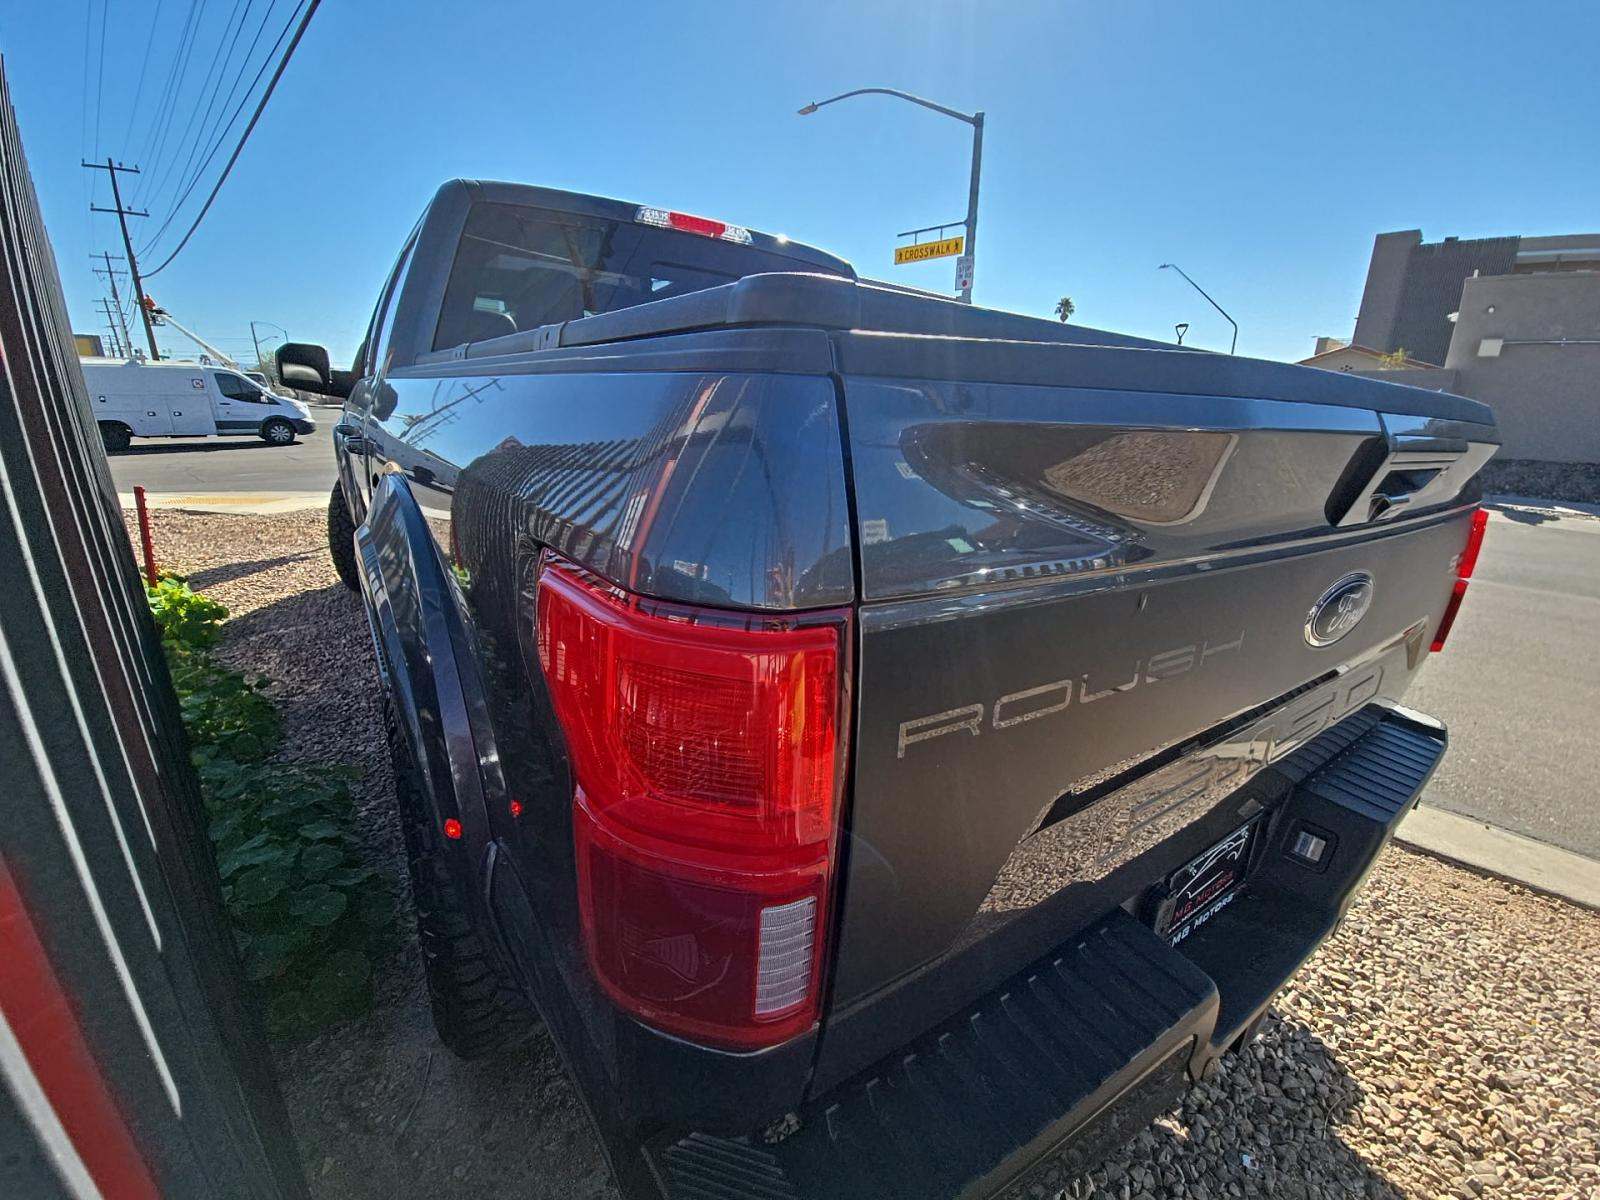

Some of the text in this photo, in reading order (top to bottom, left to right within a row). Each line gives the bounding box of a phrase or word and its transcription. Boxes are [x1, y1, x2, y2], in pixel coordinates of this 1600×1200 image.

[904, 243, 950, 260] CROSSWALK
[897, 630, 1246, 760] ROUSH
[1193, 892, 1235, 930] MOTORS
